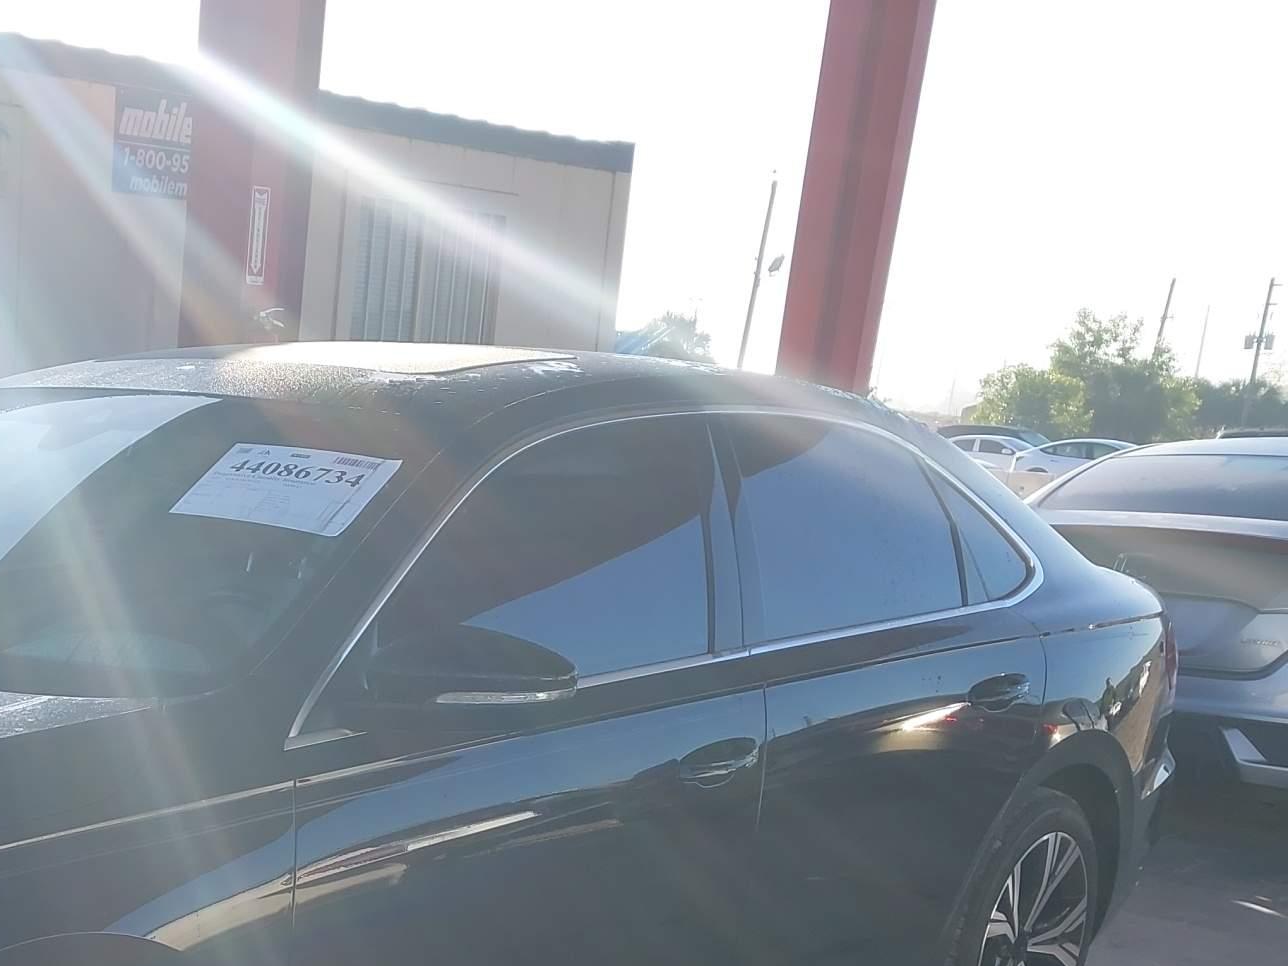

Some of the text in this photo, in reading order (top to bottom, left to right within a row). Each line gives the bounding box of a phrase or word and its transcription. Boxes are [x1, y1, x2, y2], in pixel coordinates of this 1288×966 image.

[119, 98, 192, 144] mobile
[123, 146, 190, 174] 1-800-95
[230, 458, 366, 488] 44086734
